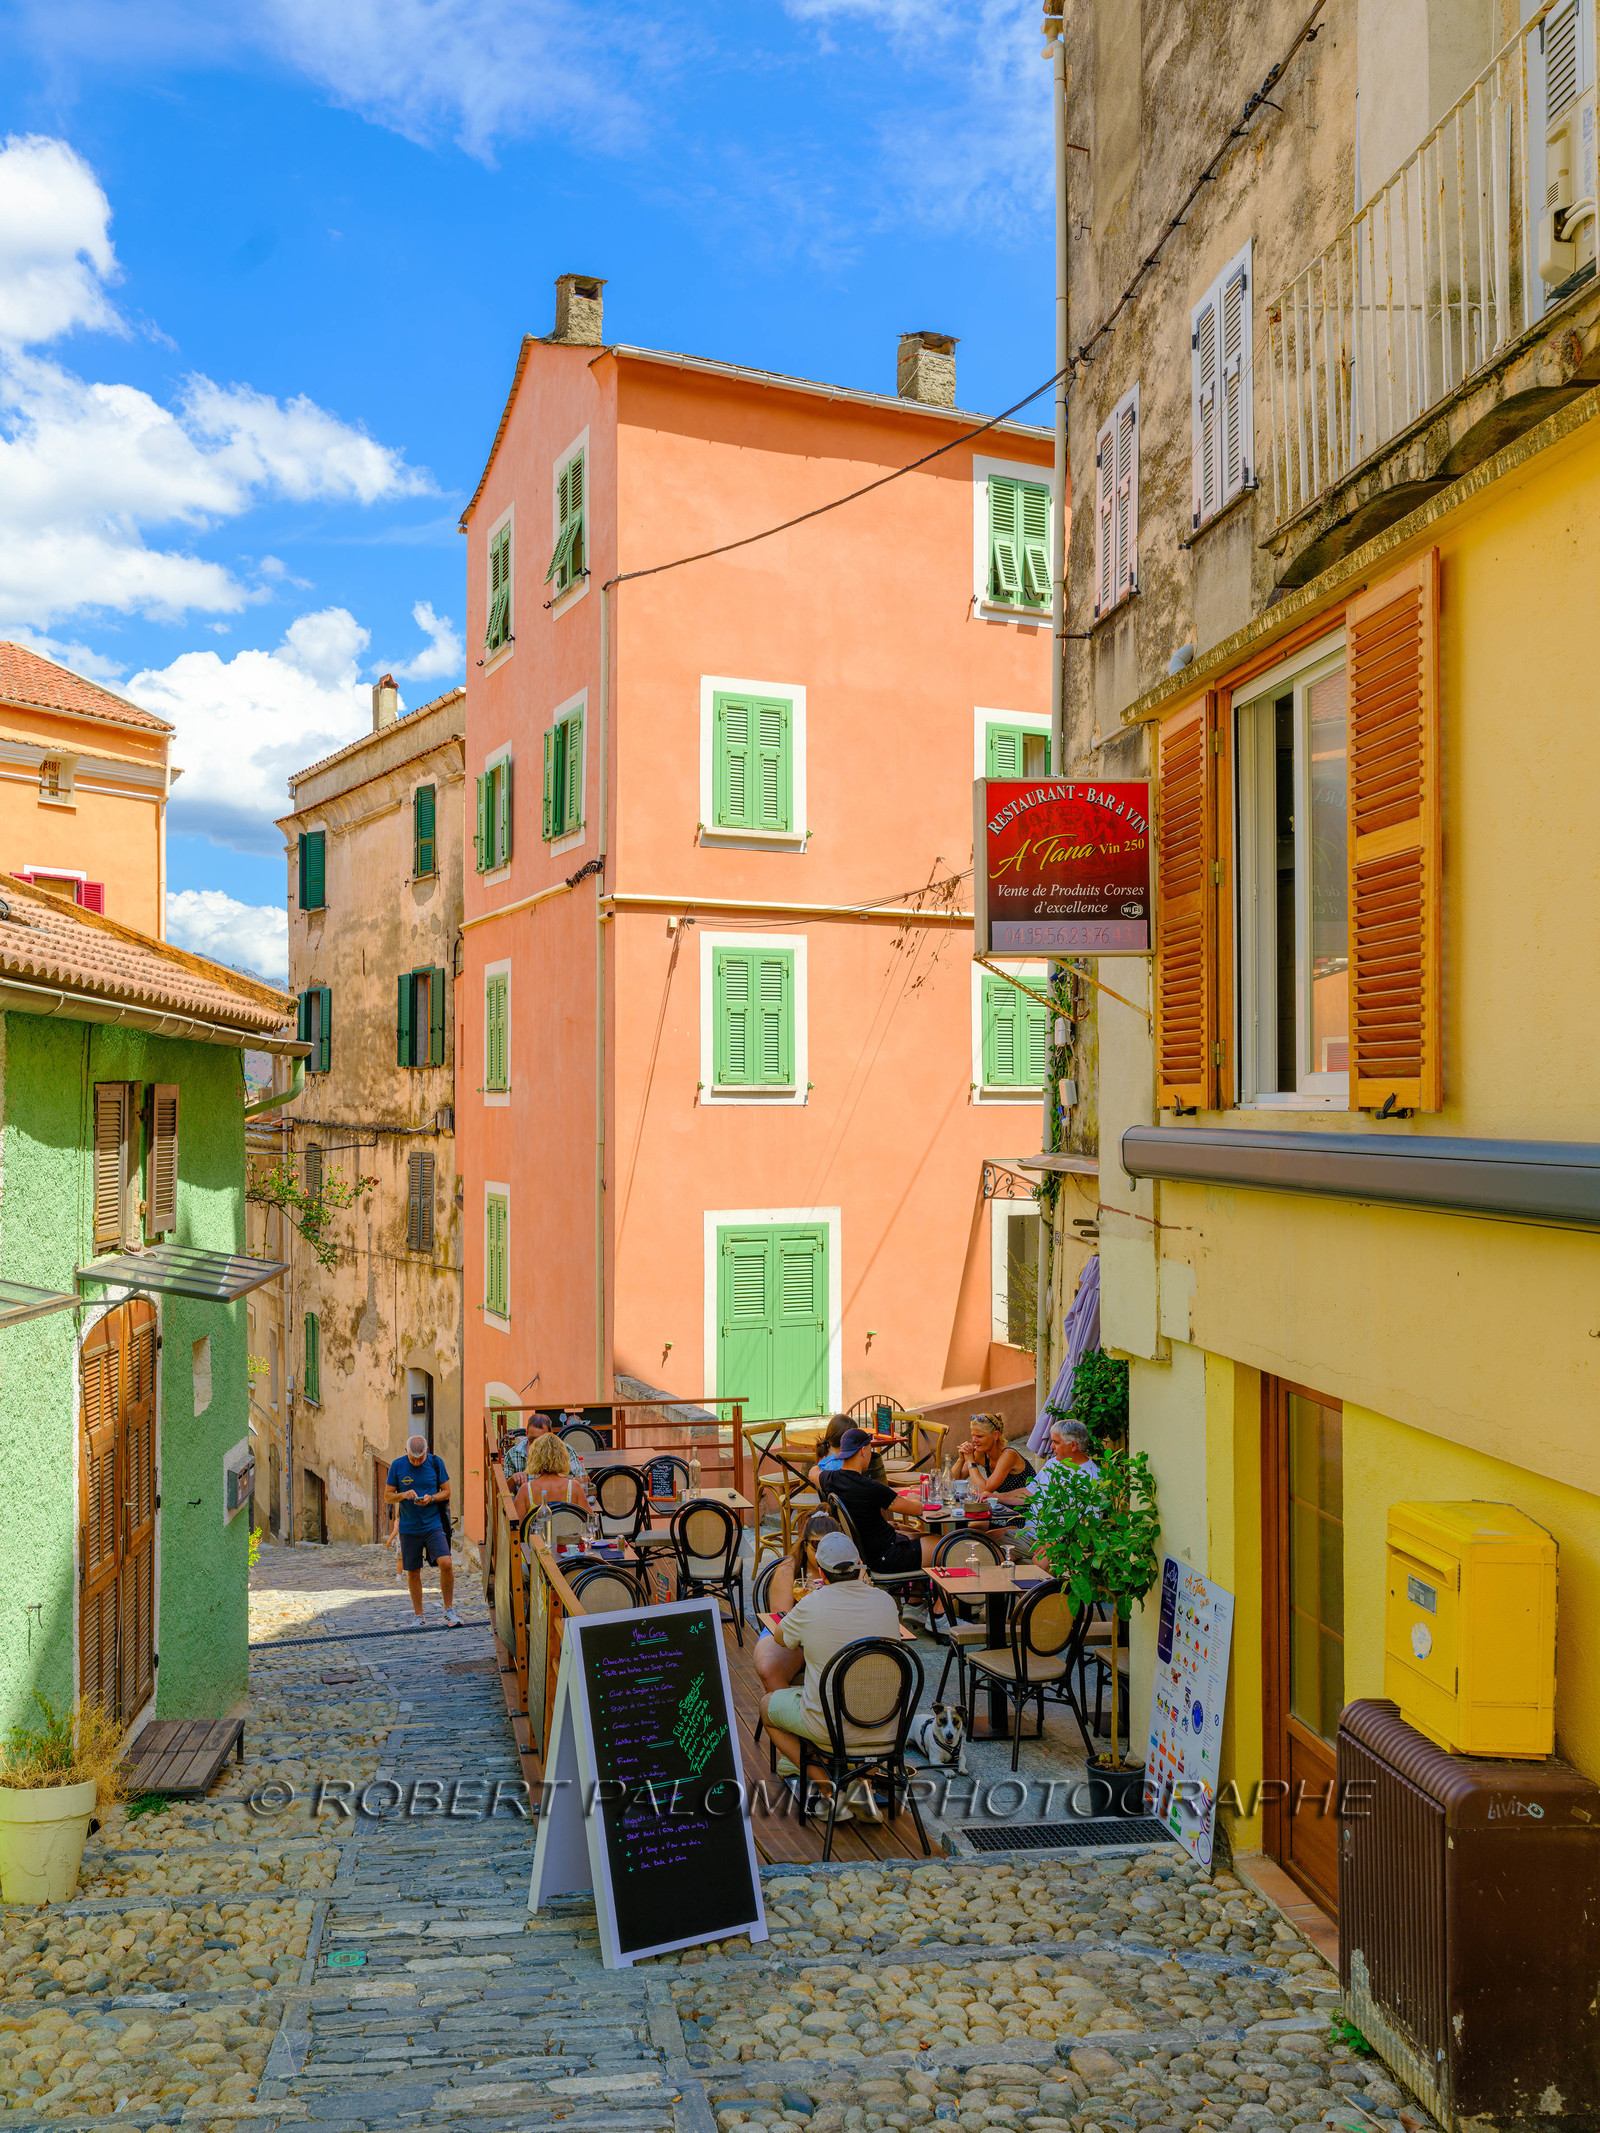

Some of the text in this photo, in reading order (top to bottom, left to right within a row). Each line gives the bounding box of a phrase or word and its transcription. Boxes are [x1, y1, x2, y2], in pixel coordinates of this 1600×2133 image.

[987, 785, 1075, 836] RESTAURANT
[1086, 787, 1116, 811] BAR
[1115, 801, 1125, 816] à
[1126, 807, 1149, 836] VIN
[989, 833, 1145, 879] A Tana Vin 250
[998, 883, 1144, 897] Vente de Produits Corses
